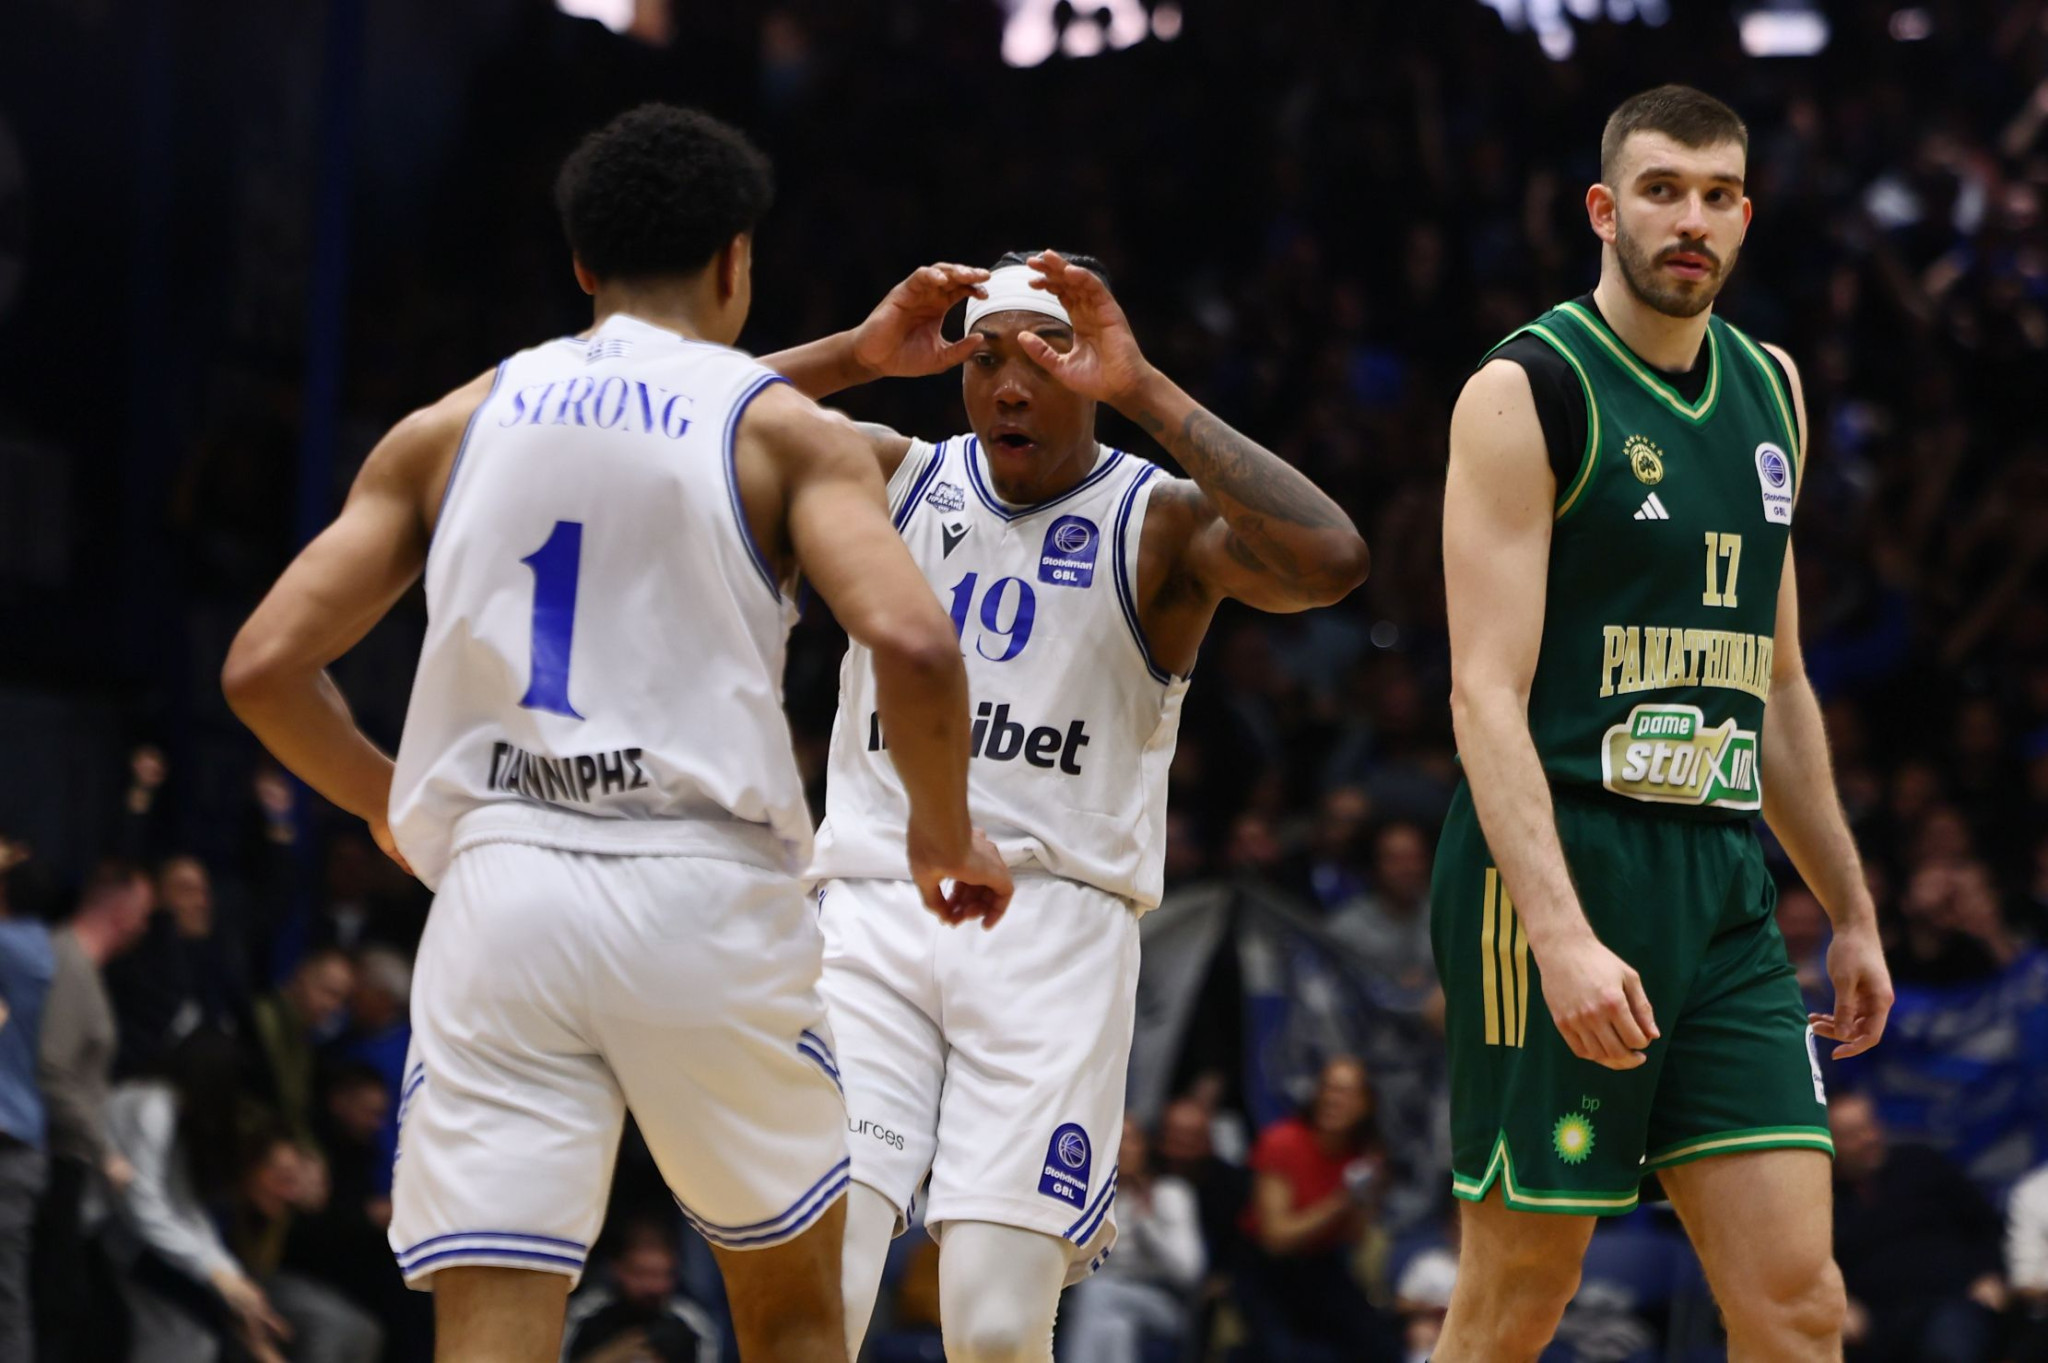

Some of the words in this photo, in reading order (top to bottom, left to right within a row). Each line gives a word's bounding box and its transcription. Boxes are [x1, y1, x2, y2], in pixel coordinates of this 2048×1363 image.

[498, 376, 694, 440] STRONG
[1042, 556, 1093, 570] Stoiximan
[1702, 531, 1742, 609] 17
[1052, 569, 1078, 582] GBL
[519, 520, 586, 721] 1
[950, 572, 1036, 662] 19
[1636, 715, 1691, 737] pame
[1582, 1095, 1600, 1113] bp
[1053, 1182, 1075, 1200] GBL
